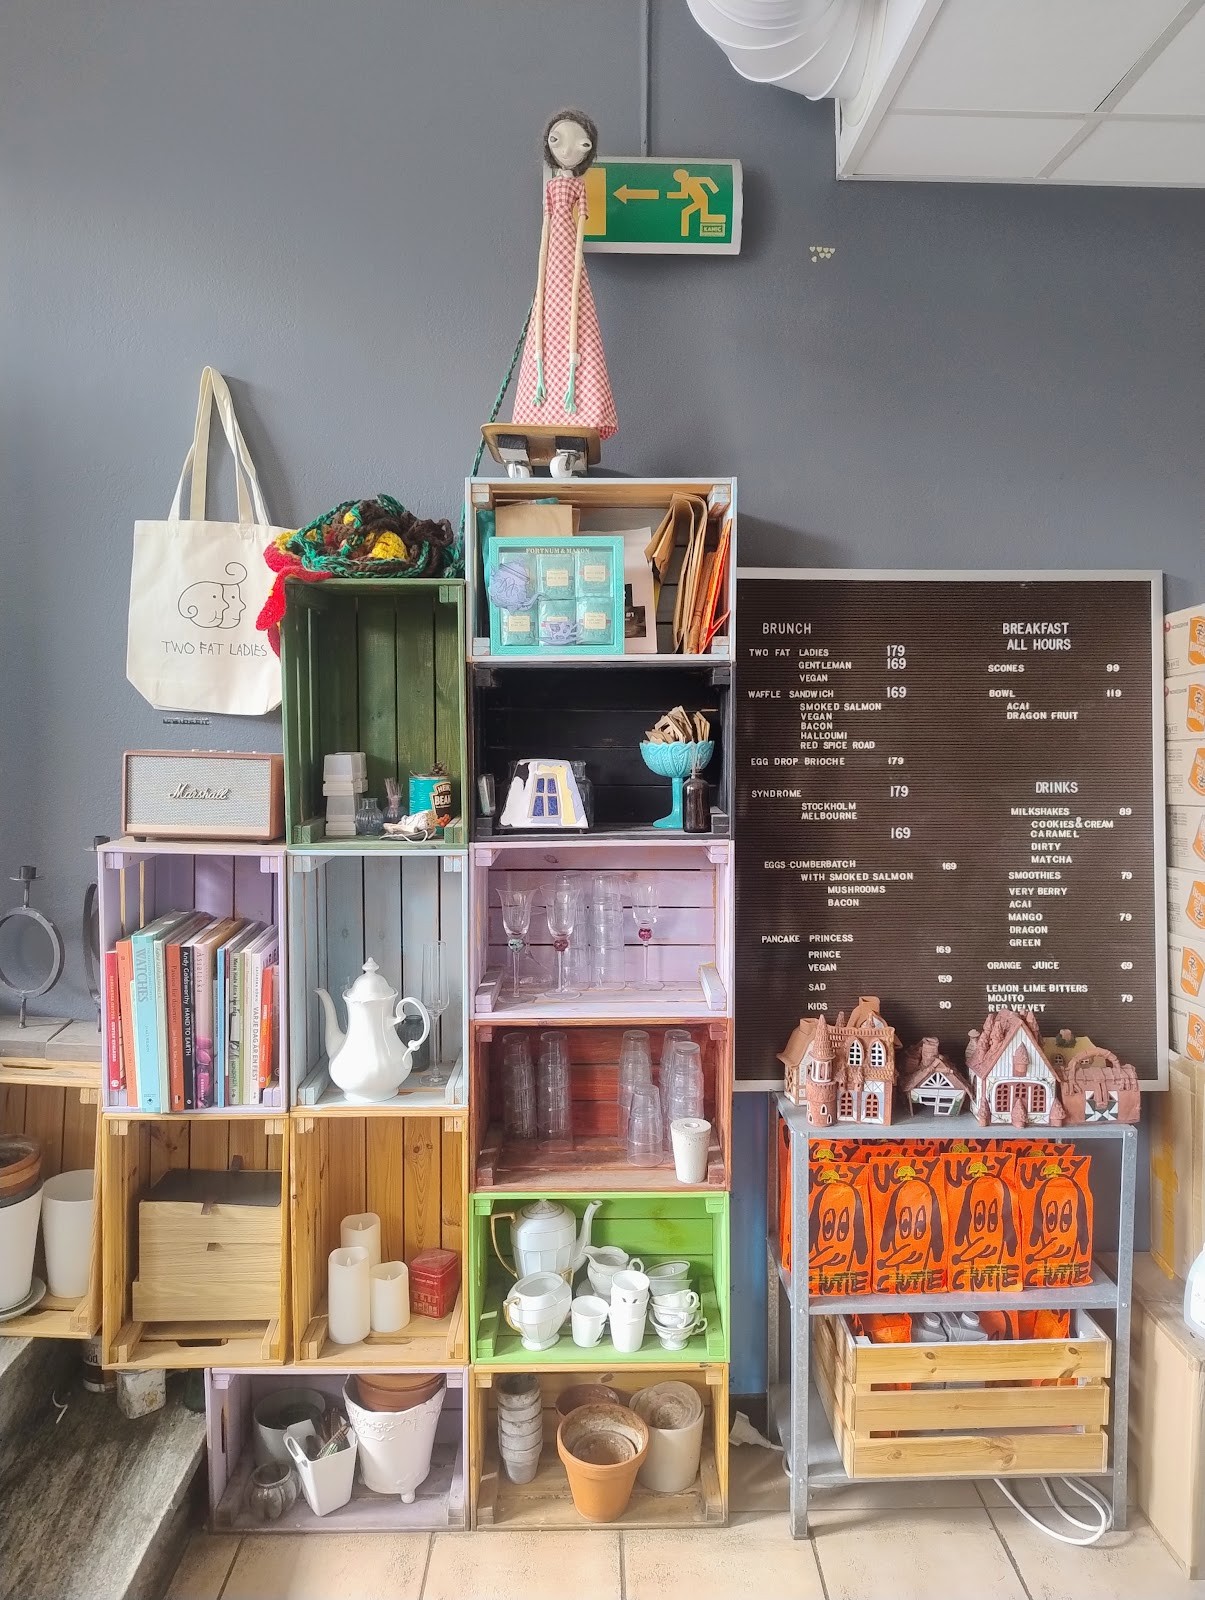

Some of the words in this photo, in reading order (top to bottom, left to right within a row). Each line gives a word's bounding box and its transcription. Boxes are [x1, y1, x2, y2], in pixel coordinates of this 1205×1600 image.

[762, 622, 811, 634] BRUNCH
[1002, 622, 1069, 634] BREAKFAST
[162, 640, 194, 656] TWO
[200, 642, 224, 656] FAT
[230, 643, 268, 656] LADIES
[1007, 638, 1028, 650] ALL
[1033, 638, 1071, 650] HOURS
[775, 648, 790, 656] FAT
[799, 648, 829, 657] LADIES
[886, 645, 905, 657] 179
[798, 661, 852, 669] GENTLEMAN
[887, 658, 906, 670] 169
[988, 664, 1025, 672] SCONES
[1106, 664, 1120, 672] 99
[799, 674, 828, 682] VEGAN
[748, 690, 781, 698] WAFFLE
[789, 690, 834, 698] SANDWICH
[886, 686, 907, 698] 169
[989, 689, 1016, 698] BOWL
[1106, 689, 1122, 697] 119
[800, 702, 840, 711] SMOKED
[844, 702, 882, 711] SALMON
[1006, 702, 1029, 710] ACAI
[800, 712, 832, 720] VEGAN
[1006, 712, 1047, 720] DRAGON
[1051, 712, 1078, 720] FRUIT
[801, 722, 833, 730] BACON
[801, 731, 848, 740] HALLOUMI
[800, 741, 818, 750] RED
[823, 741, 848, 749] SPICE
[852, 741, 875, 749] ROAD
[774, 758, 799, 766] DROP
[804, 757, 845, 766] BRIOCHE
[888, 757, 904, 765] 179
[168, 782, 229, 800] Marshall
[752, 789, 802, 798] SYNDROME
[890, 785, 909, 797] 179
[1036, 782, 1078, 793] DRINKS
[801, 802, 856, 810] STOCKHOLM
[801, 812, 858, 820] MELBOURNE
[1011, 807, 1070, 816] MILKSHAKES
[1119, 807, 1132, 816] 89
[891, 827, 911, 839] 169
[1030, 830, 1080, 838] CARAMEL
[1031, 842, 1061, 851] DIRTY
[1031, 855, 1072, 864] MATCHA
[764, 861, 786, 869] EGGS
[789, 860, 856, 868] CUMBERBATCH
[942, 862, 957, 870] 169
[800, 873, 825, 881] WITH
[829, 872, 869, 881] SMOKED
[872, 872, 913, 881] SALMON
[1008, 871, 1062, 880] SMOOTHIES
[1121, 872, 1132, 880] 79
[828, 885, 886, 894] MUSHROOMS
[1008, 888, 1034, 896] VERY
[1037, 887, 1068, 896] BERRY
[828, 898, 859, 907] BACON
[1009, 900, 1032, 908] ACAI
[1008, 913, 1043, 921] MANGO
[1119, 913, 1132, 921] 79
[1009, 926, 1048, 934] DRAGON
[762, 934, 800, 943] PANCAKE
[809, 934, 854, 942] PRINCESS
[1009, 938, 1041, 946] GREEN
[808, 950, 841, 958] PRINCE
[936, 946, 951, 954] 169
[808, 963, 837, 972] VEGAN
[986, 961, 1022, 970] ORANGE
[1032, 961, 1059, 970] JUICE
[1120, 962, 1133, 970] 69
[136, 948, 148, 1003] WATCHES
[938, 974, 952, 983] 159
[808, 983, 826, 991] SAD
[986, 984, 1019, 992] LEMON
[1023, 984, 1046, 992] LIME
[1048, 984, 1088, 993] BITTERS
[988, 994, 1024, 1002] MOJITO
[1121, 994, 1133, 1002] 79
[808, 1002, 828, 1010] KIDS
[939, 1001, 952, 1009] 90
[185, 1027, 191, 1036] TO
